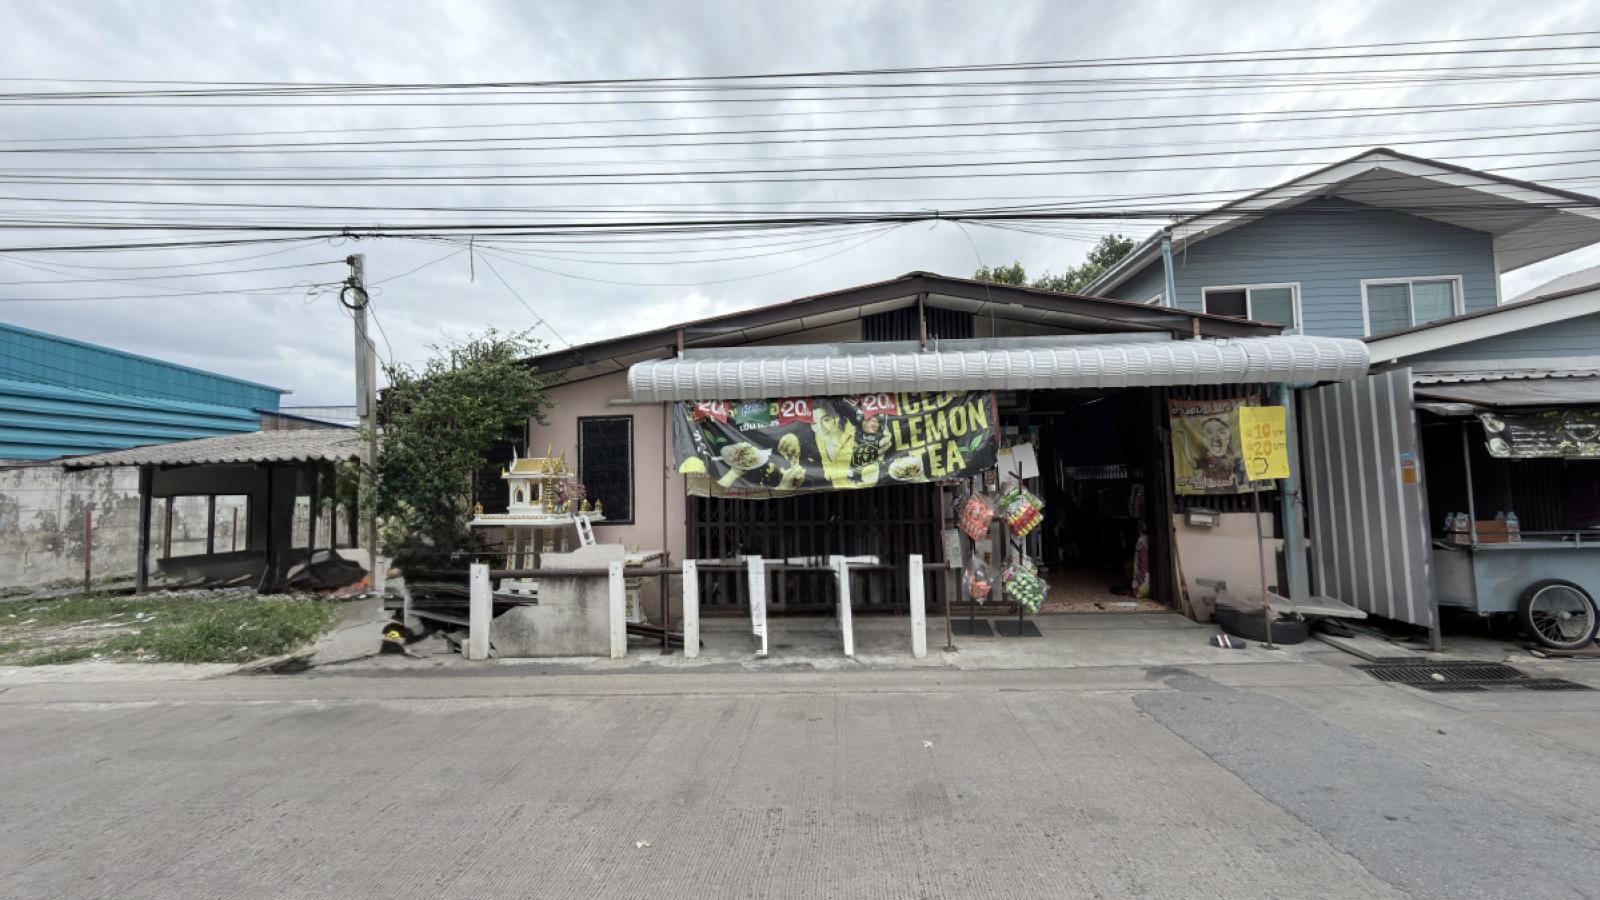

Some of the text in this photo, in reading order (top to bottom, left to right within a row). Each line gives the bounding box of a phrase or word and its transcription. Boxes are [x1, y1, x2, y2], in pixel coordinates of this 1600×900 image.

[892, 398, 989, 451] LEMON
[1254, 423, 1271, 439] 10
[909, 440, 967, 478] TEA
[1254, 441, 1272, 456] 20
